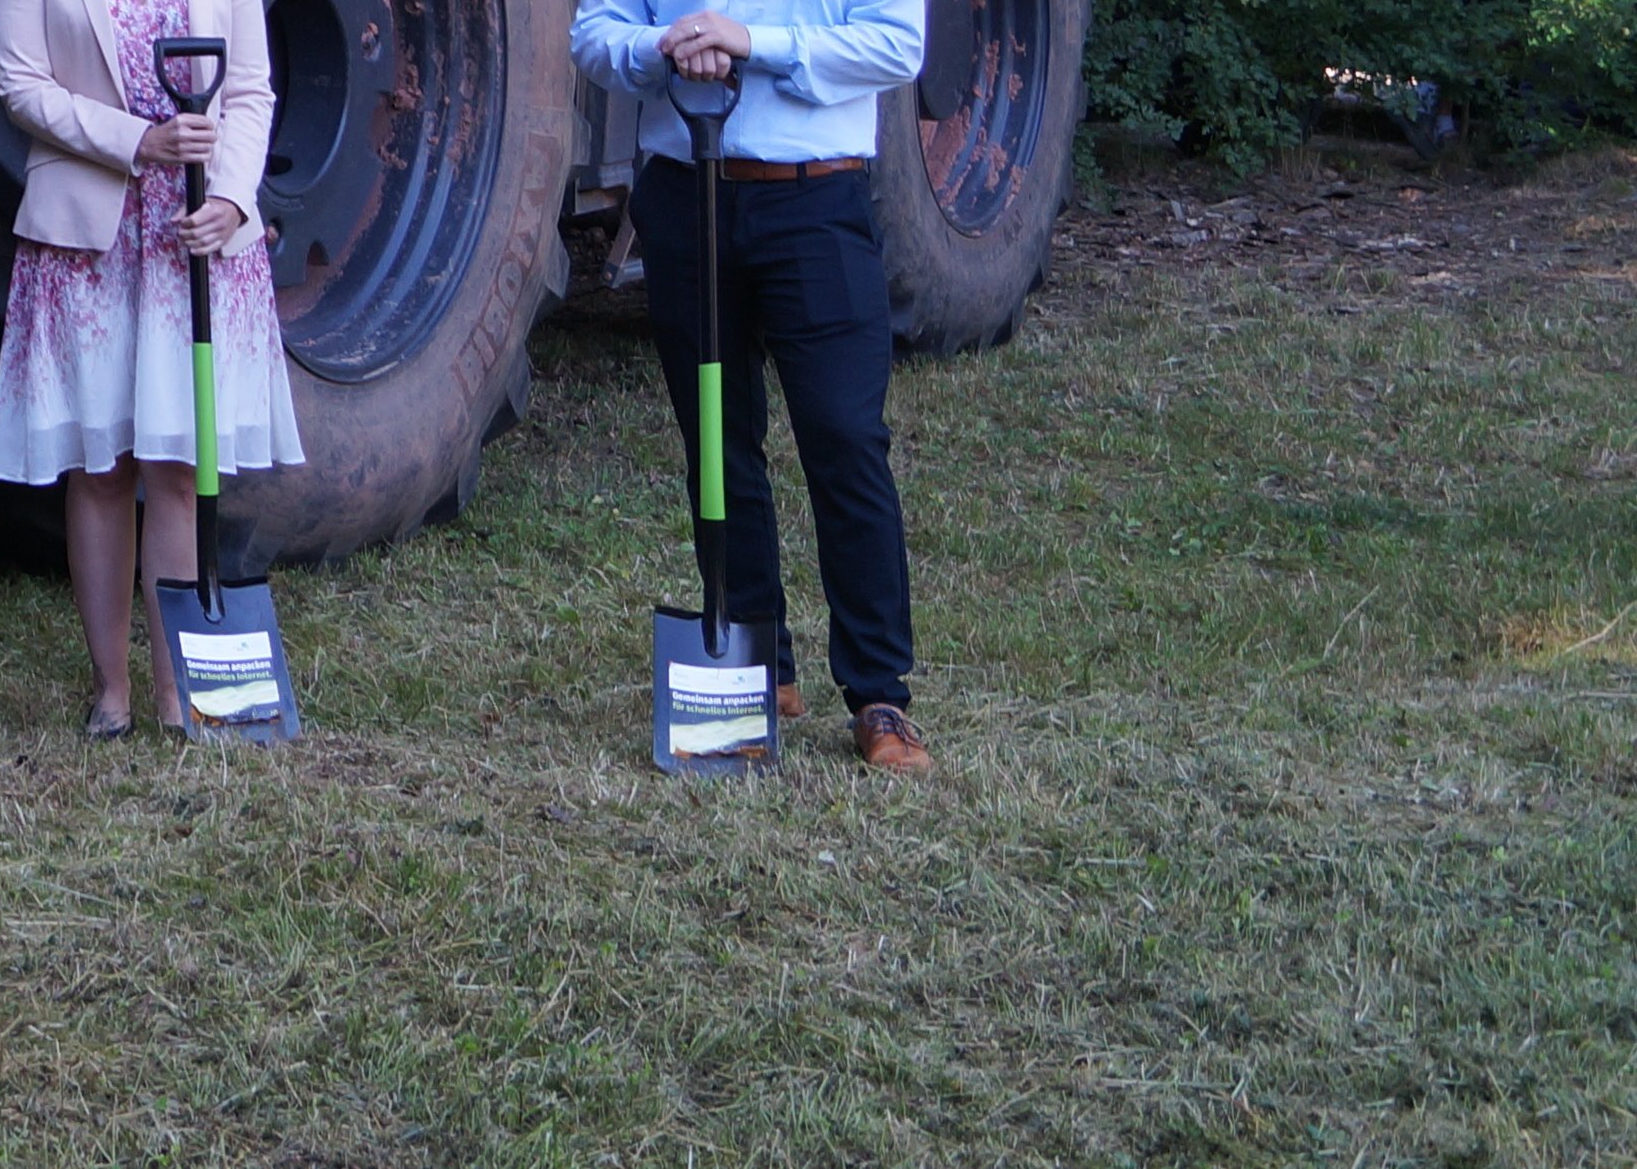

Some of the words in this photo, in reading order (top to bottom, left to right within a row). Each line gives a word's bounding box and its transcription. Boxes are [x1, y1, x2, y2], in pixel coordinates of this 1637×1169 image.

[186, 659, 230, 672] Gemeinsam
[231, 659, 271, 672] anpacken
[671, 690, 722, 705] Gemeinsam
[724, 693, 764, 707] anpacken
[686, 703, 727, 715] schnelles
[728, 703, 764, 715] Internet.
